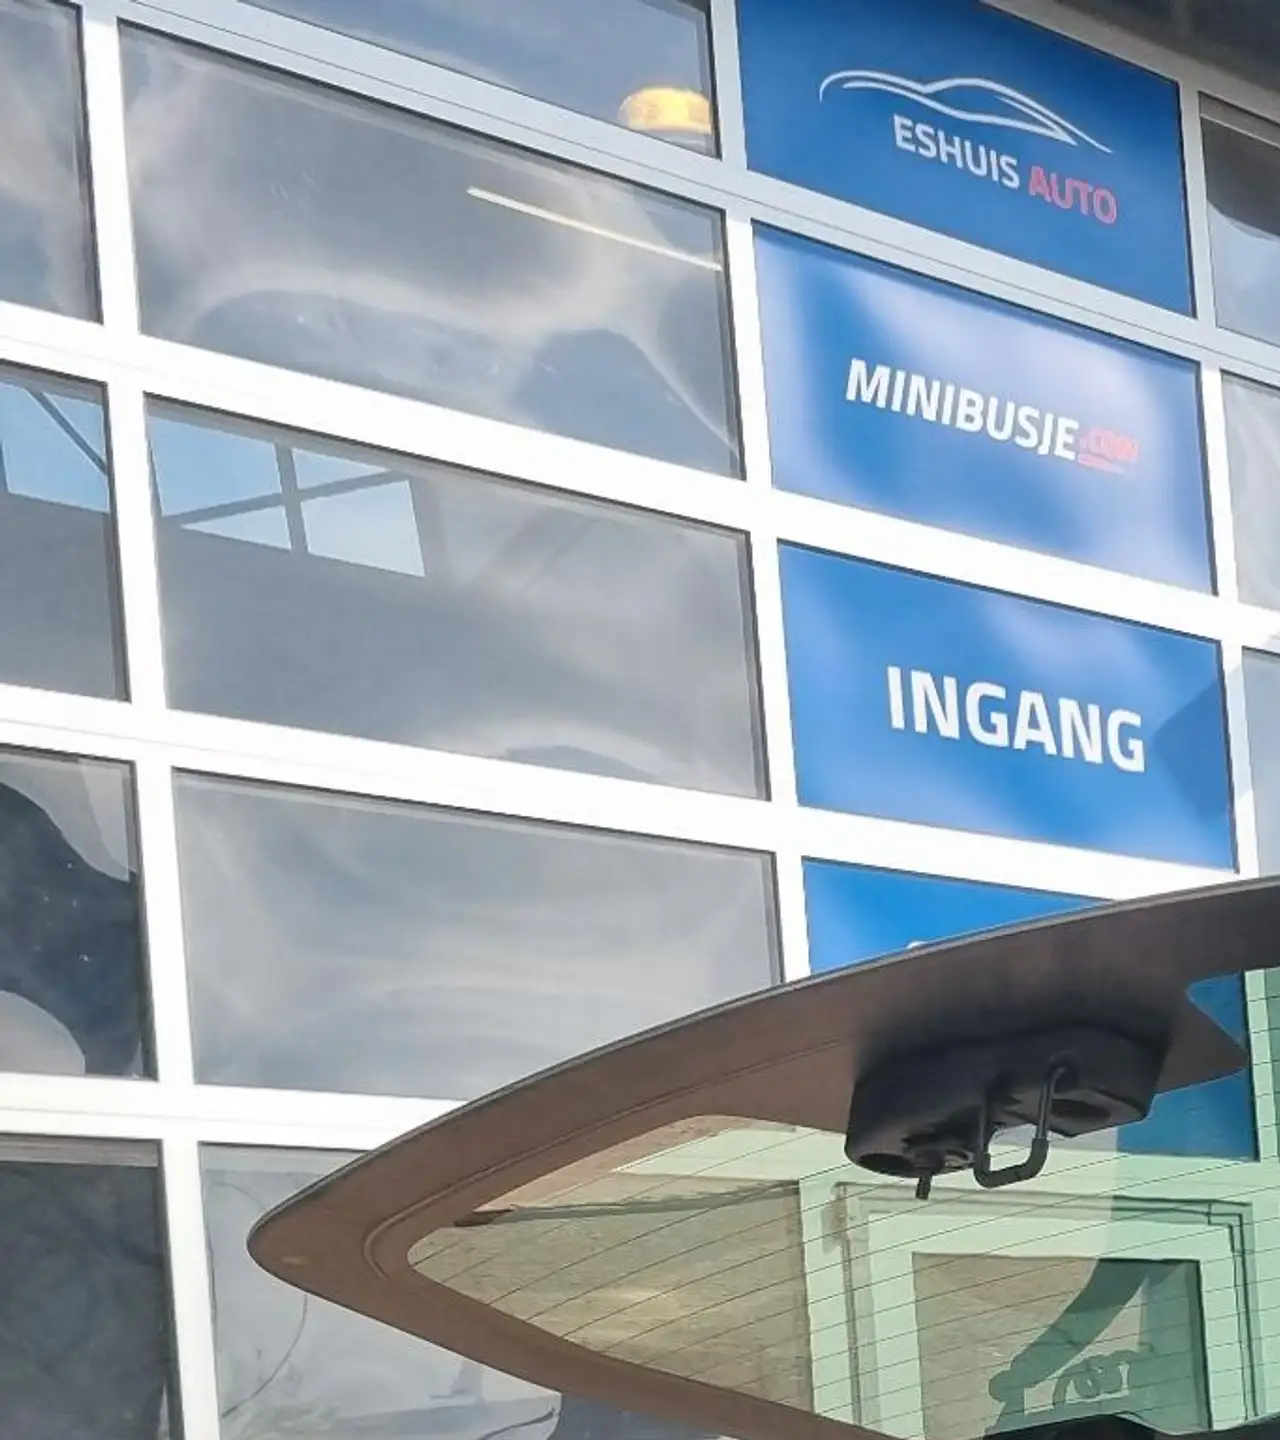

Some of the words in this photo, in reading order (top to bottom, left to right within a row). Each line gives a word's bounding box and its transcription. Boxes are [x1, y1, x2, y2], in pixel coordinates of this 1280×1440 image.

[893, 114, 1020, 190] ESHUIS
[1028, 165, 1117, 224] AUTO
[887, 665, 1145, 773] INGANG
